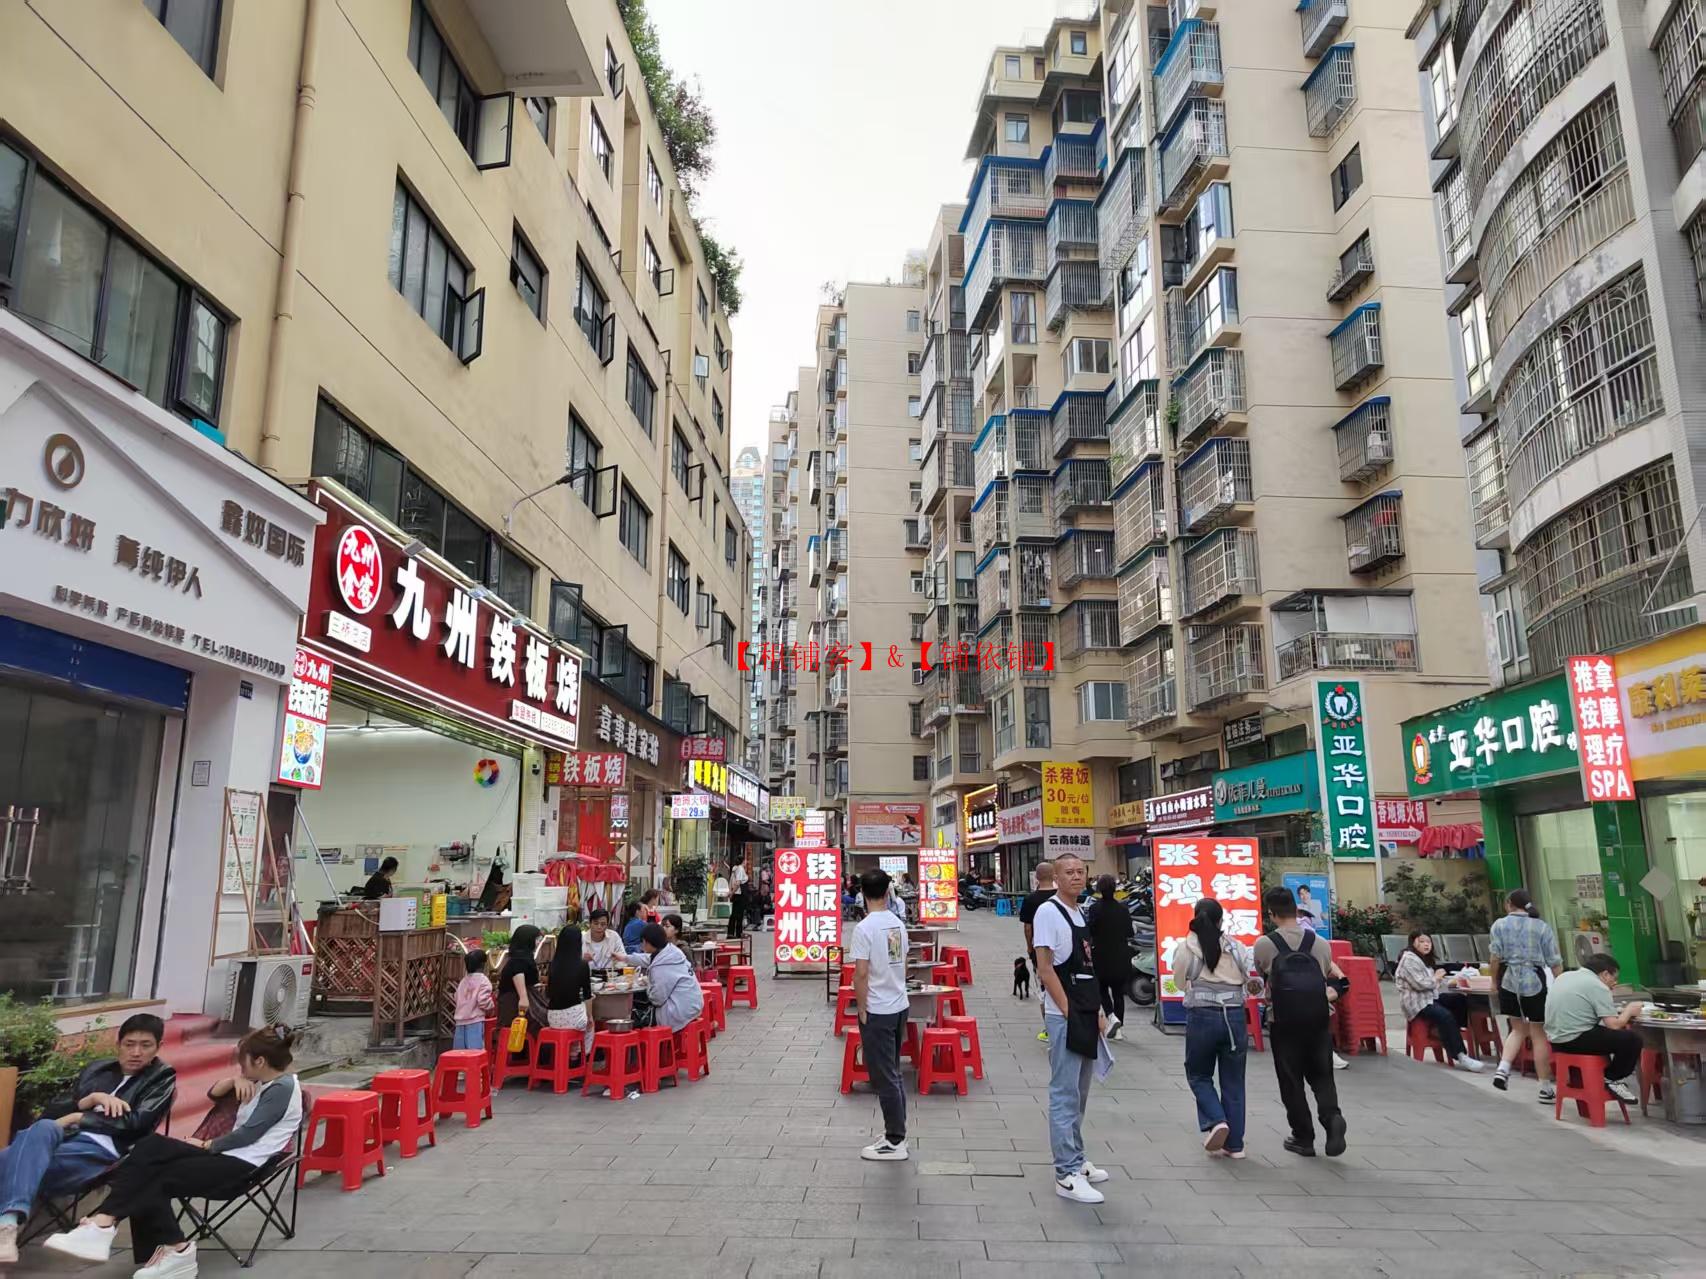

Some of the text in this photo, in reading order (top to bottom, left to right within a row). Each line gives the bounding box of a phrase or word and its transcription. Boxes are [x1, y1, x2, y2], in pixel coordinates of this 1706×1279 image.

[114, 534, 203, 598] 纯伊人
[392, 557, 579, 716] 九州铁板烧
[306, 659, 331, 684] 九州
[1573, 660, 1614, 693] 推拿
[288, 677, 330, 721] 铁板烧
[1578, 697, 1620, 730] 按摩
[1449, 699, 1566, 773] 亚华口腔
[1583, 733, 1624, 766] 理疗
[563, 754, 622, 784] 铁板烧
[1045, 767, 1089, 784] 杀猪饭
[1591, 770, 1631, 798] SPA
[1046, 788, 1089, 803] 30元/位
[1330, 735, 1371, 850] 亚华口腔
[1158, 843, 1255, 867] 张记
[778, 879, 802, 943] 九州
[806, 852, 837, 943] 铁板烧
